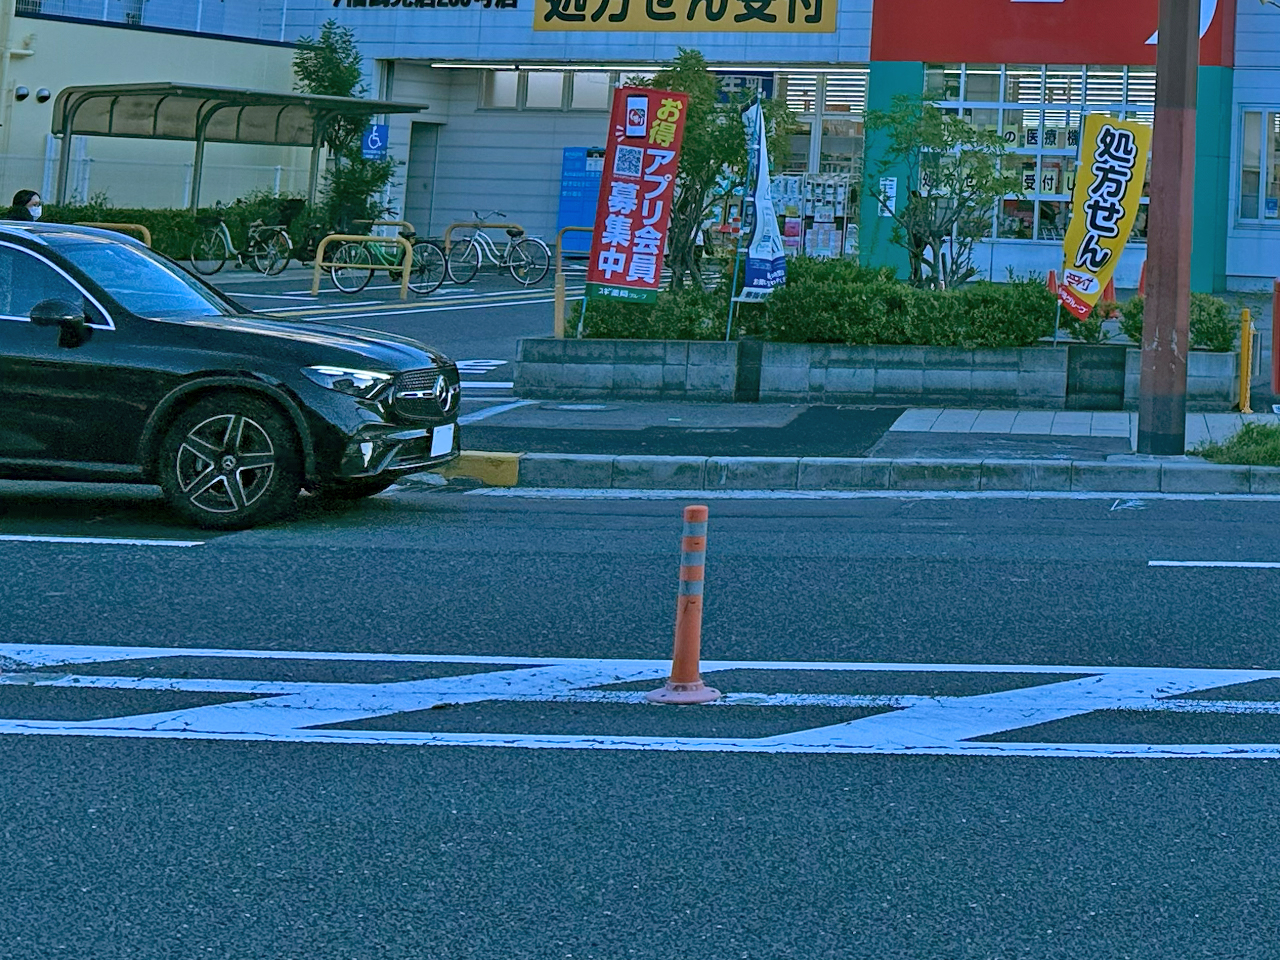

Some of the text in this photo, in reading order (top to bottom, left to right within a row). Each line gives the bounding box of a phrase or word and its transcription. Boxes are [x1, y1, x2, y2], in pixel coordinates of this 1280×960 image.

[648, 98, 683, 147] お得
[598, 181, 640, 279] 募集中
[625, 148, 676, 284] アプリ会員
[1074, 124, 1137, 273] 処方せん
